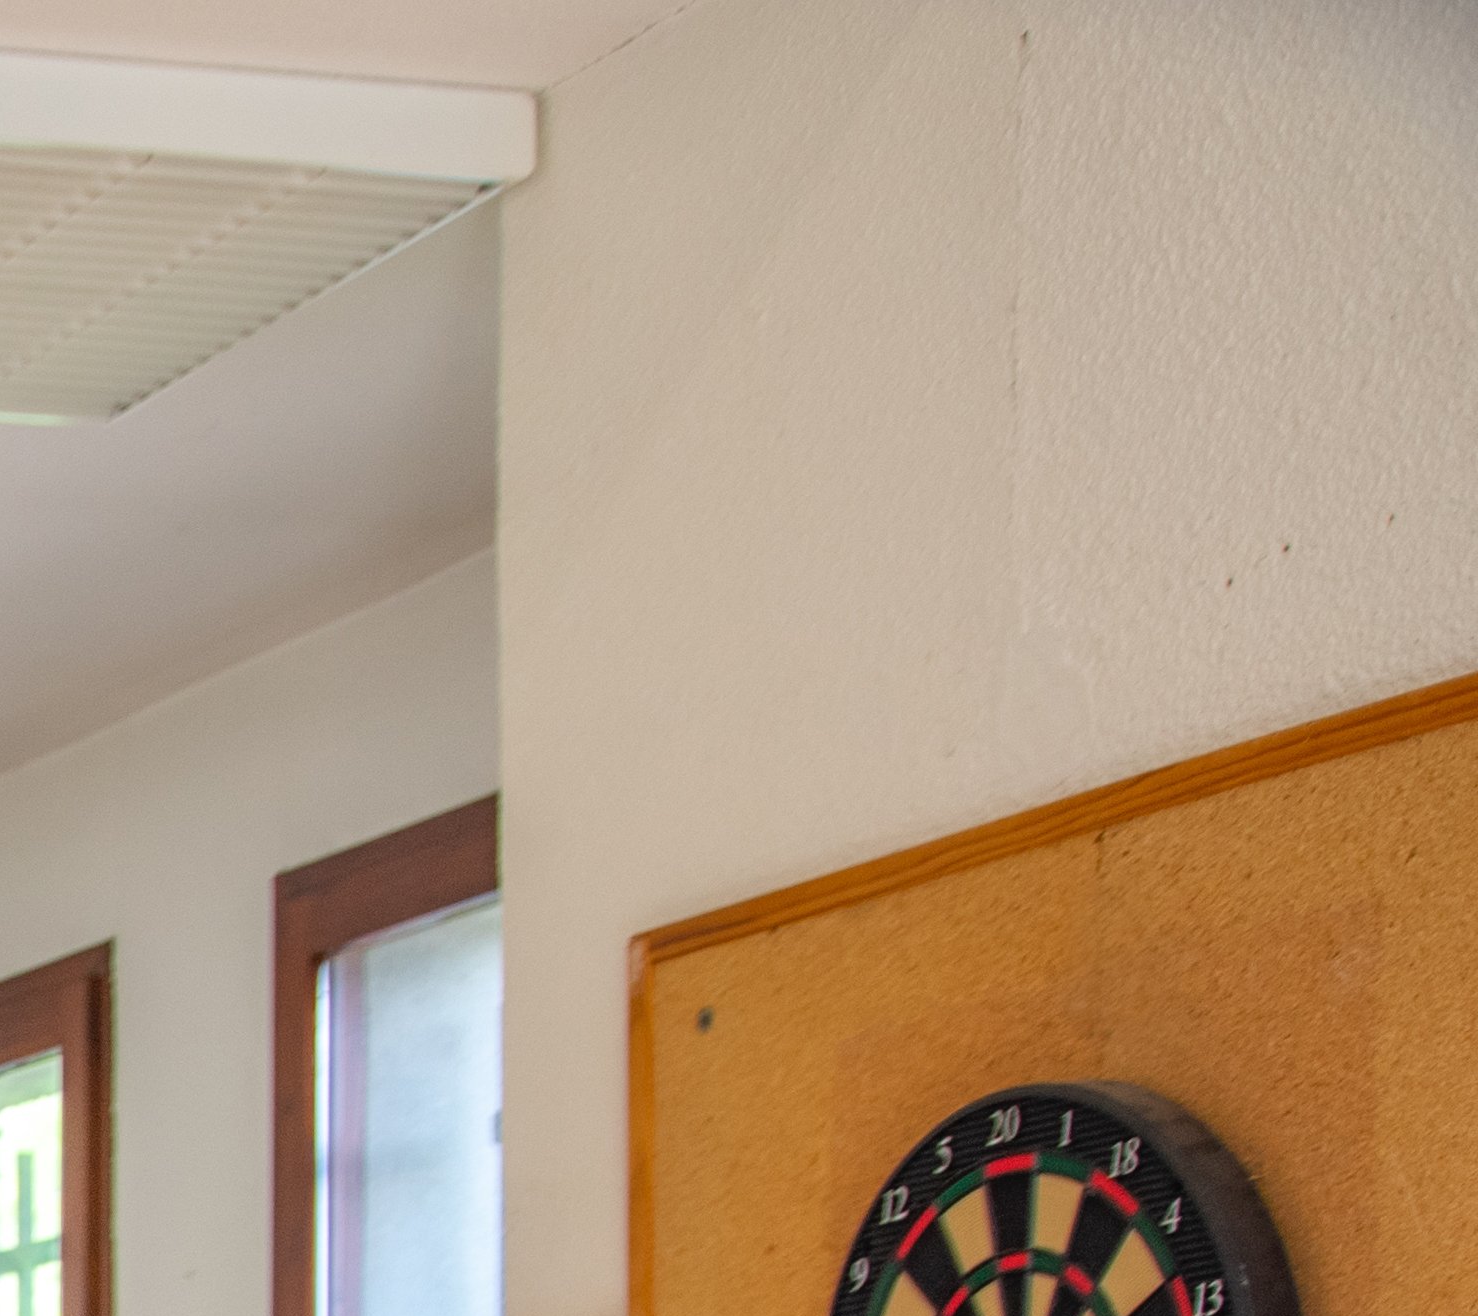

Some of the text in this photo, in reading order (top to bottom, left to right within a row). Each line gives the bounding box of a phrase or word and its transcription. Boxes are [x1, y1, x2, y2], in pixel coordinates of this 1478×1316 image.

[988, 1106, 1020, 1145] 20
[1059, 1110, 1072, 1147] 1
[933, 1136, 952, 1174] 5
[1108, 1137, 1140, 1179] 18
[879, 1186, 909, 1225] 12
[1160, 1197, 1181, 1234] 4
[849, 1258, 869, 1293] 9
